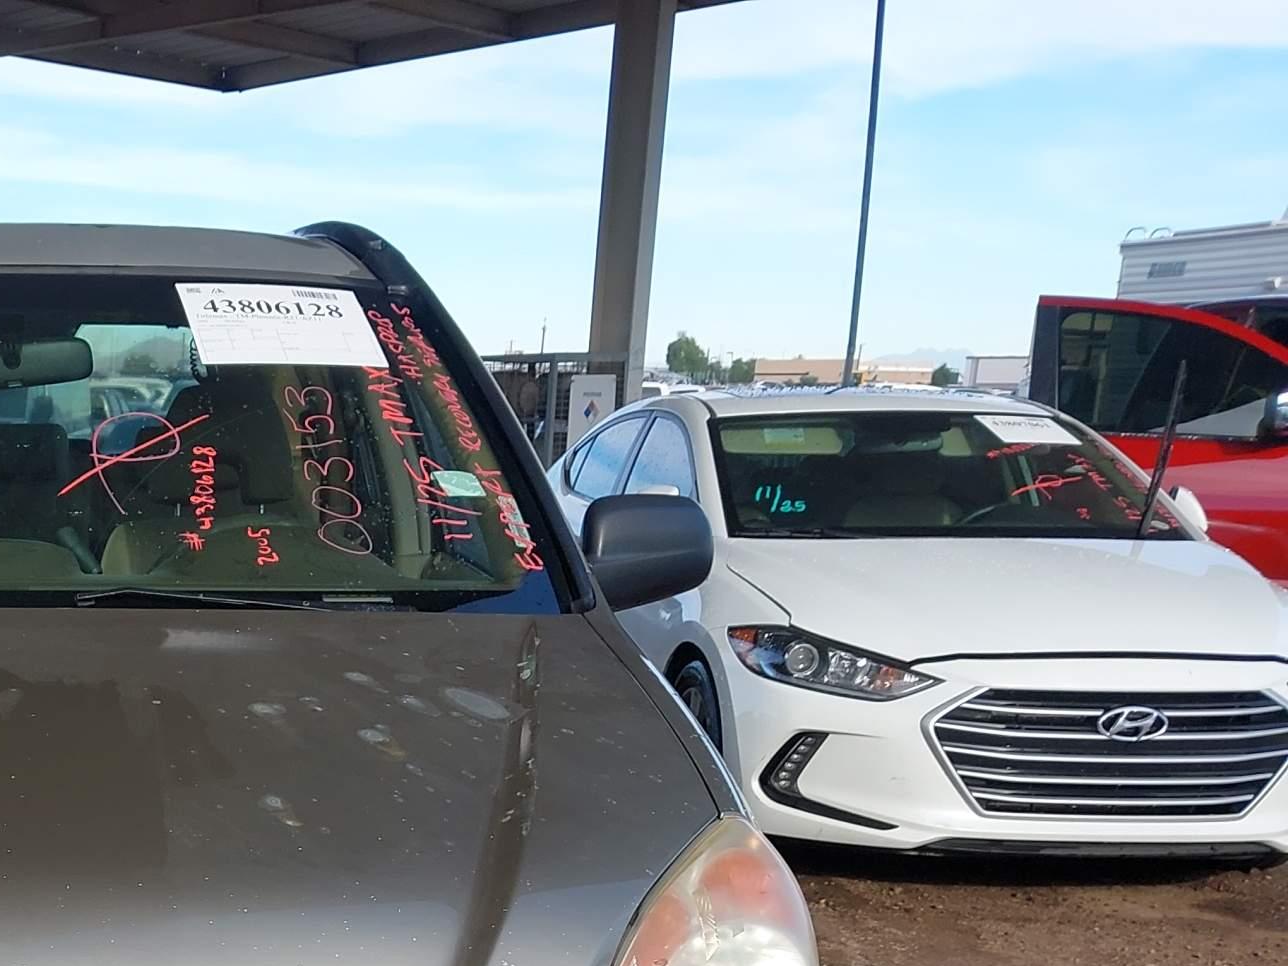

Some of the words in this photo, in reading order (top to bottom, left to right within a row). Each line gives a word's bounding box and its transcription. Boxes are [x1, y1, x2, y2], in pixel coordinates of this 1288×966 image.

[203, 299, 344, 319] 43806128
[285, 384, 373, 555] 003153
[755, 484, 806, 513] 11/25
[247, 526, 281, 568] 2005
